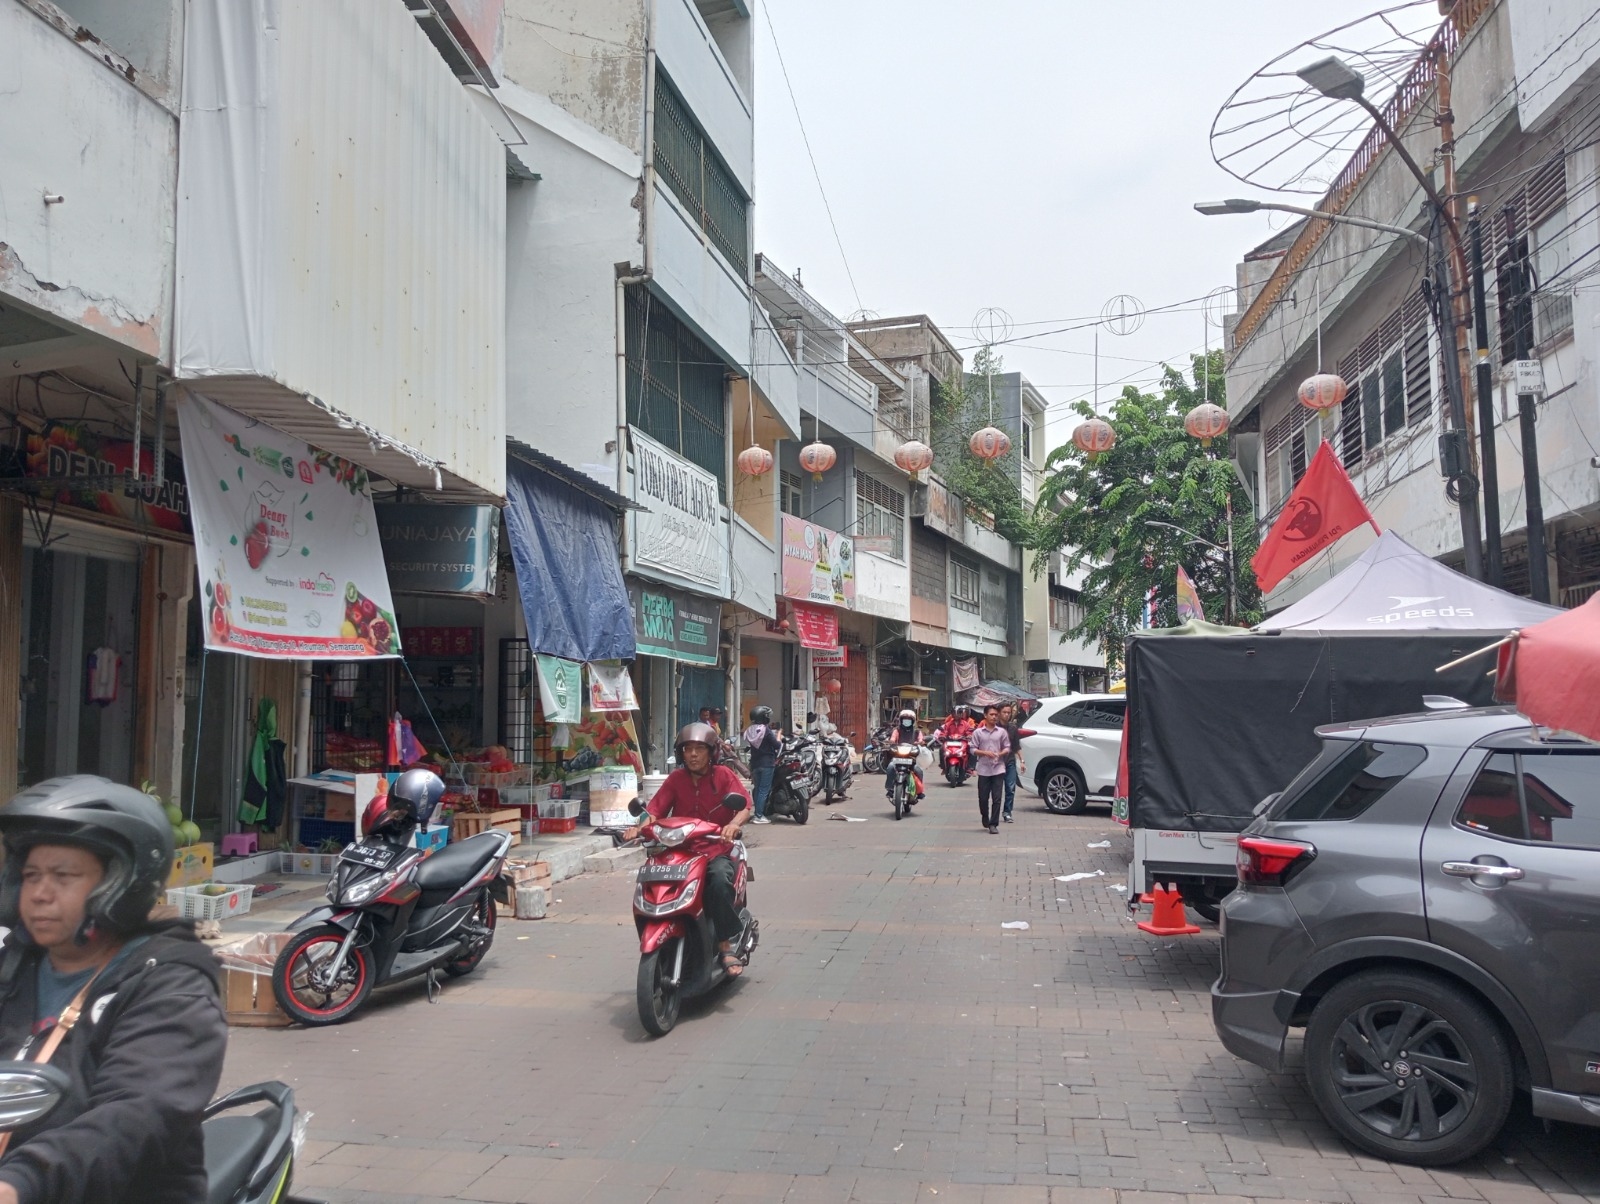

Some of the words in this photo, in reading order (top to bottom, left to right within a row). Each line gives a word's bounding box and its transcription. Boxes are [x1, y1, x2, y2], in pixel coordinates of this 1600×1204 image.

[636, 443, 666, 502] TOKO
[667, 460, 689, 514] OBAT
[689, 474, 716, 527] AGUNG
[261, 504, 287, 527] Denny
[390, 562, 438, 572] SECURITY
[642, 591, 674, 620] HERBA
[1366, 605, 1474, 624] speeds
[329, 640, 365, 652] Semarang
[379, 851, 391, 859] SP
